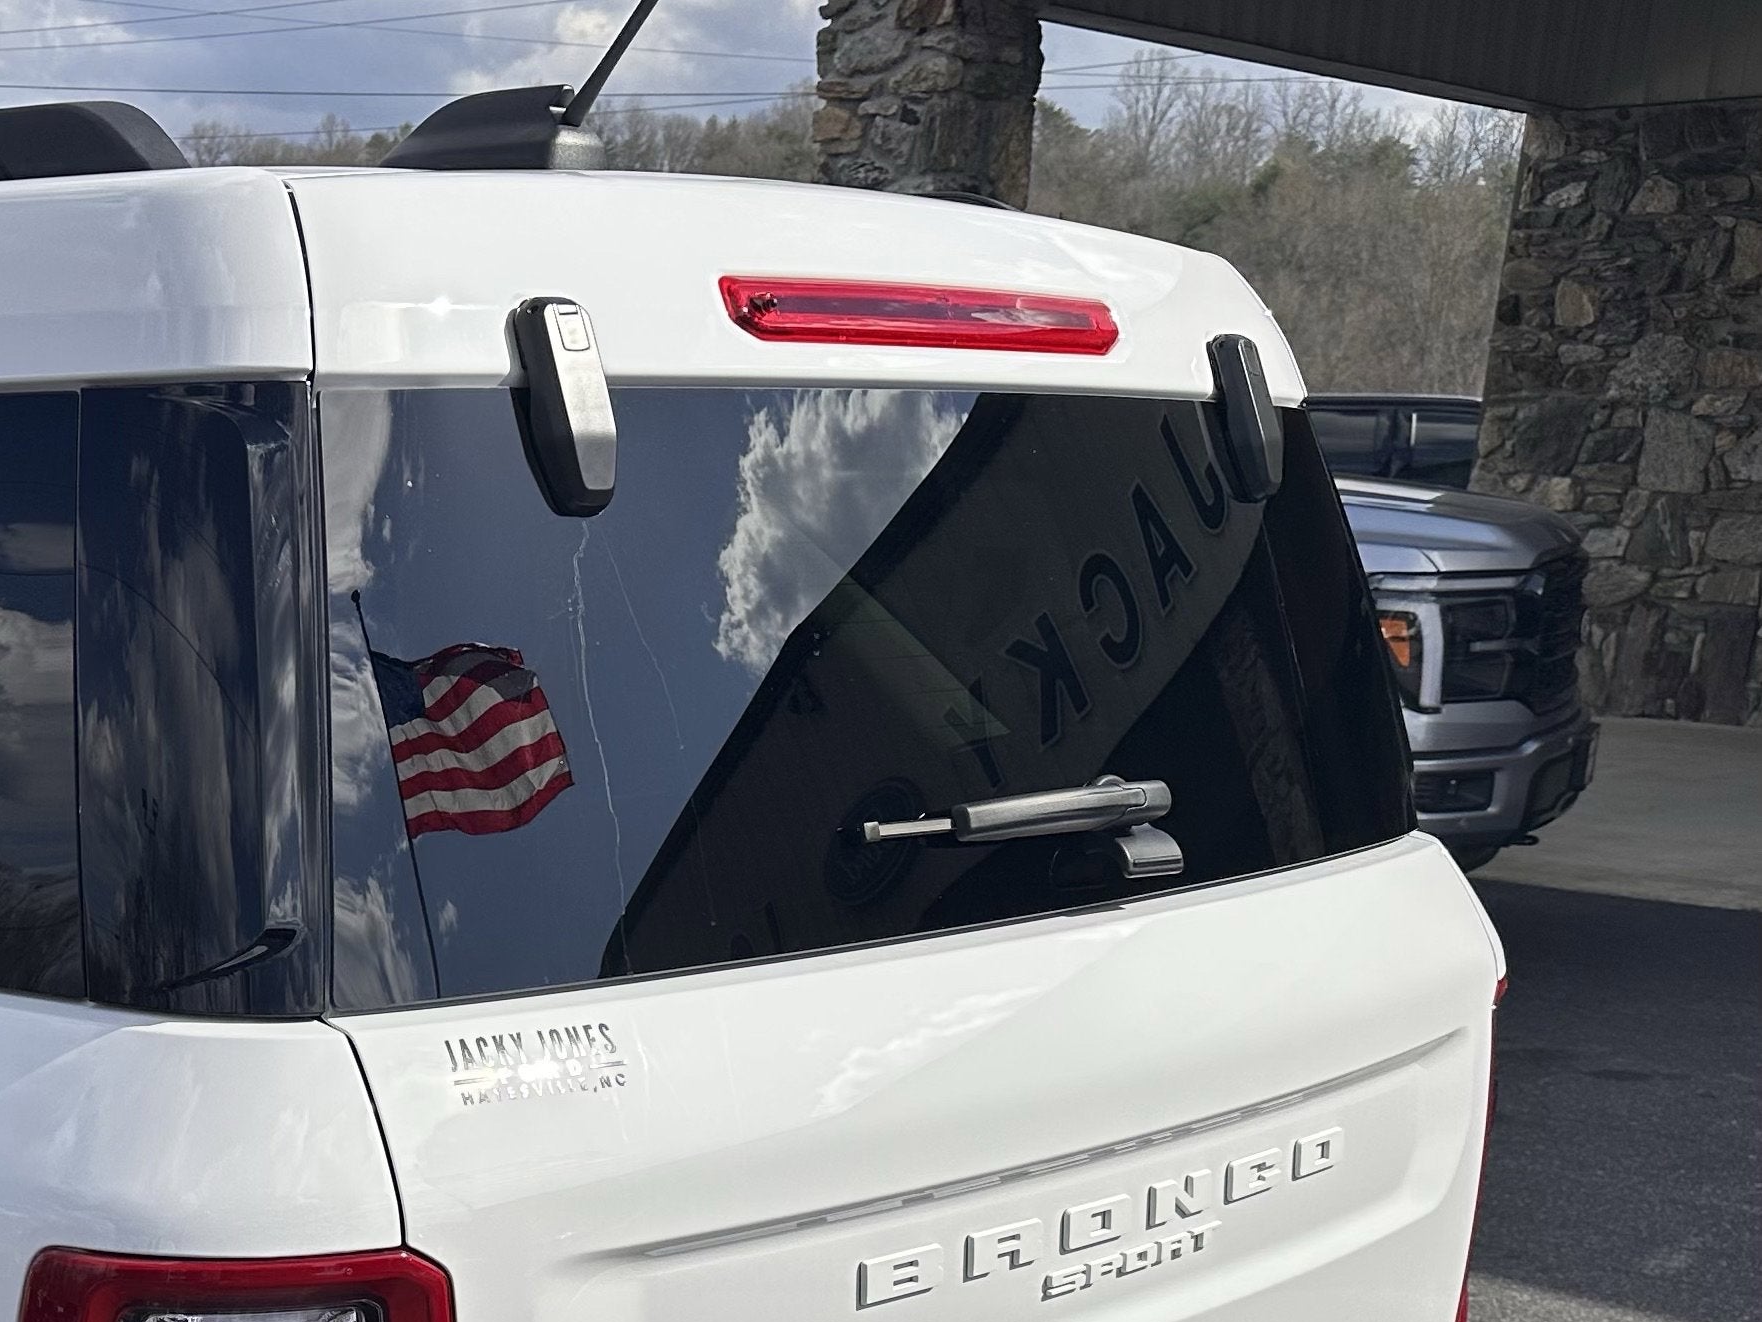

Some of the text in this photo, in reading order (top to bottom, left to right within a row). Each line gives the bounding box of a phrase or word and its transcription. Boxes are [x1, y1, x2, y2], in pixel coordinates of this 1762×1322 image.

[444, 1022, 617, 1073] JACKY JONES
[856, 1126, 1345, 1311] BRONCO
[1041, 1220, 1222, 1301] SPORT
